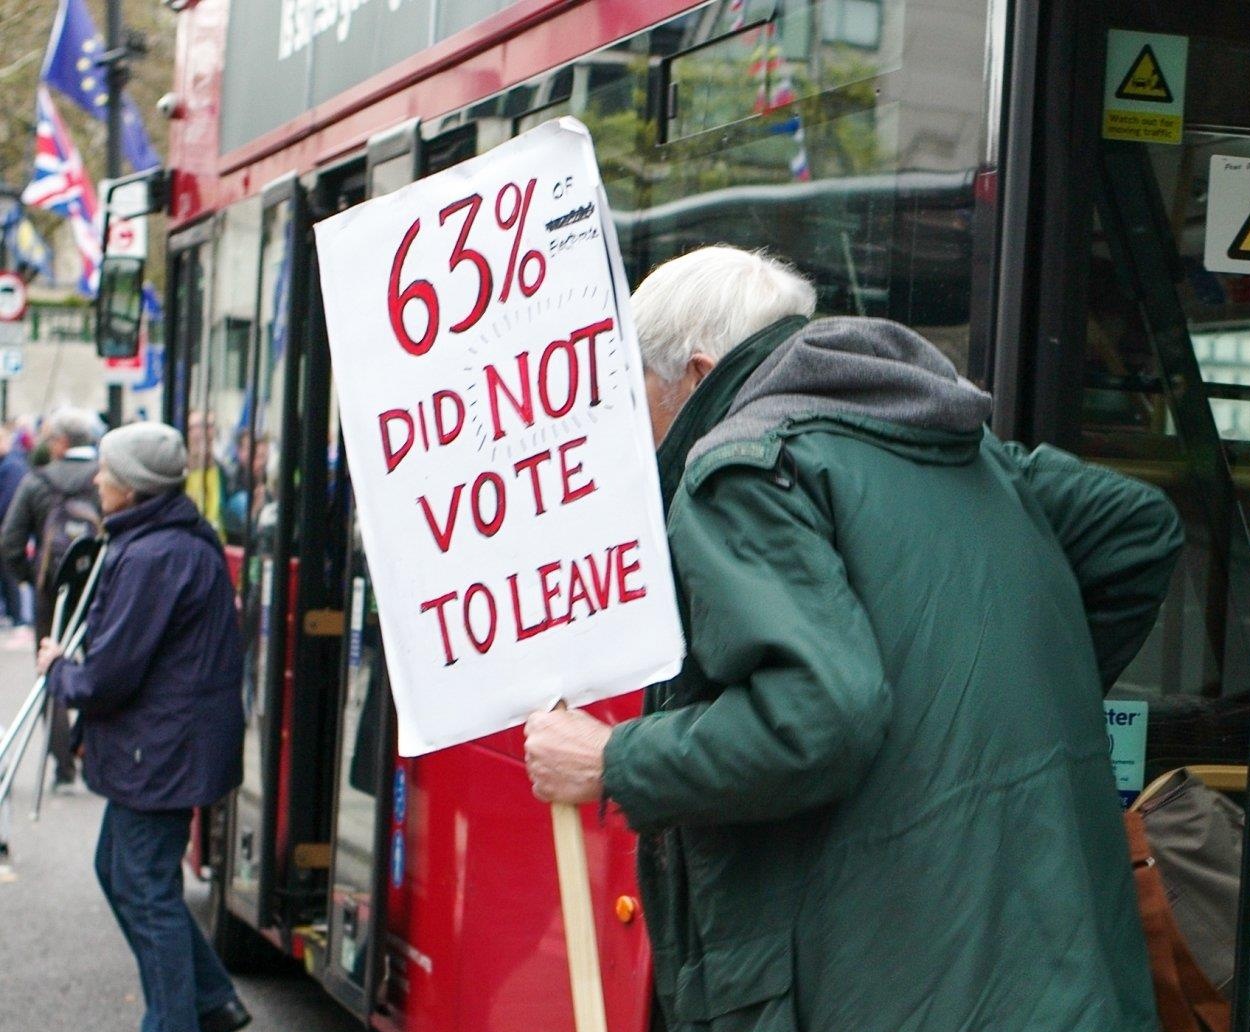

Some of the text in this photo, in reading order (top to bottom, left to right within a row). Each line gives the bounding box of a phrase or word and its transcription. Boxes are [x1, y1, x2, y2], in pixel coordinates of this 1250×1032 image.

[1108, 113, 1140, 124] Watch
[1141, 118, 1158, 126] out
[1143, 127, 1174, 138] traffic
[387, 178, 546, 356] 63%
[378, 317, 614, 474] DID NOT
[415, 435, 599, 553] VOTE
[418, 539, 647, 667] TO LEAVE
